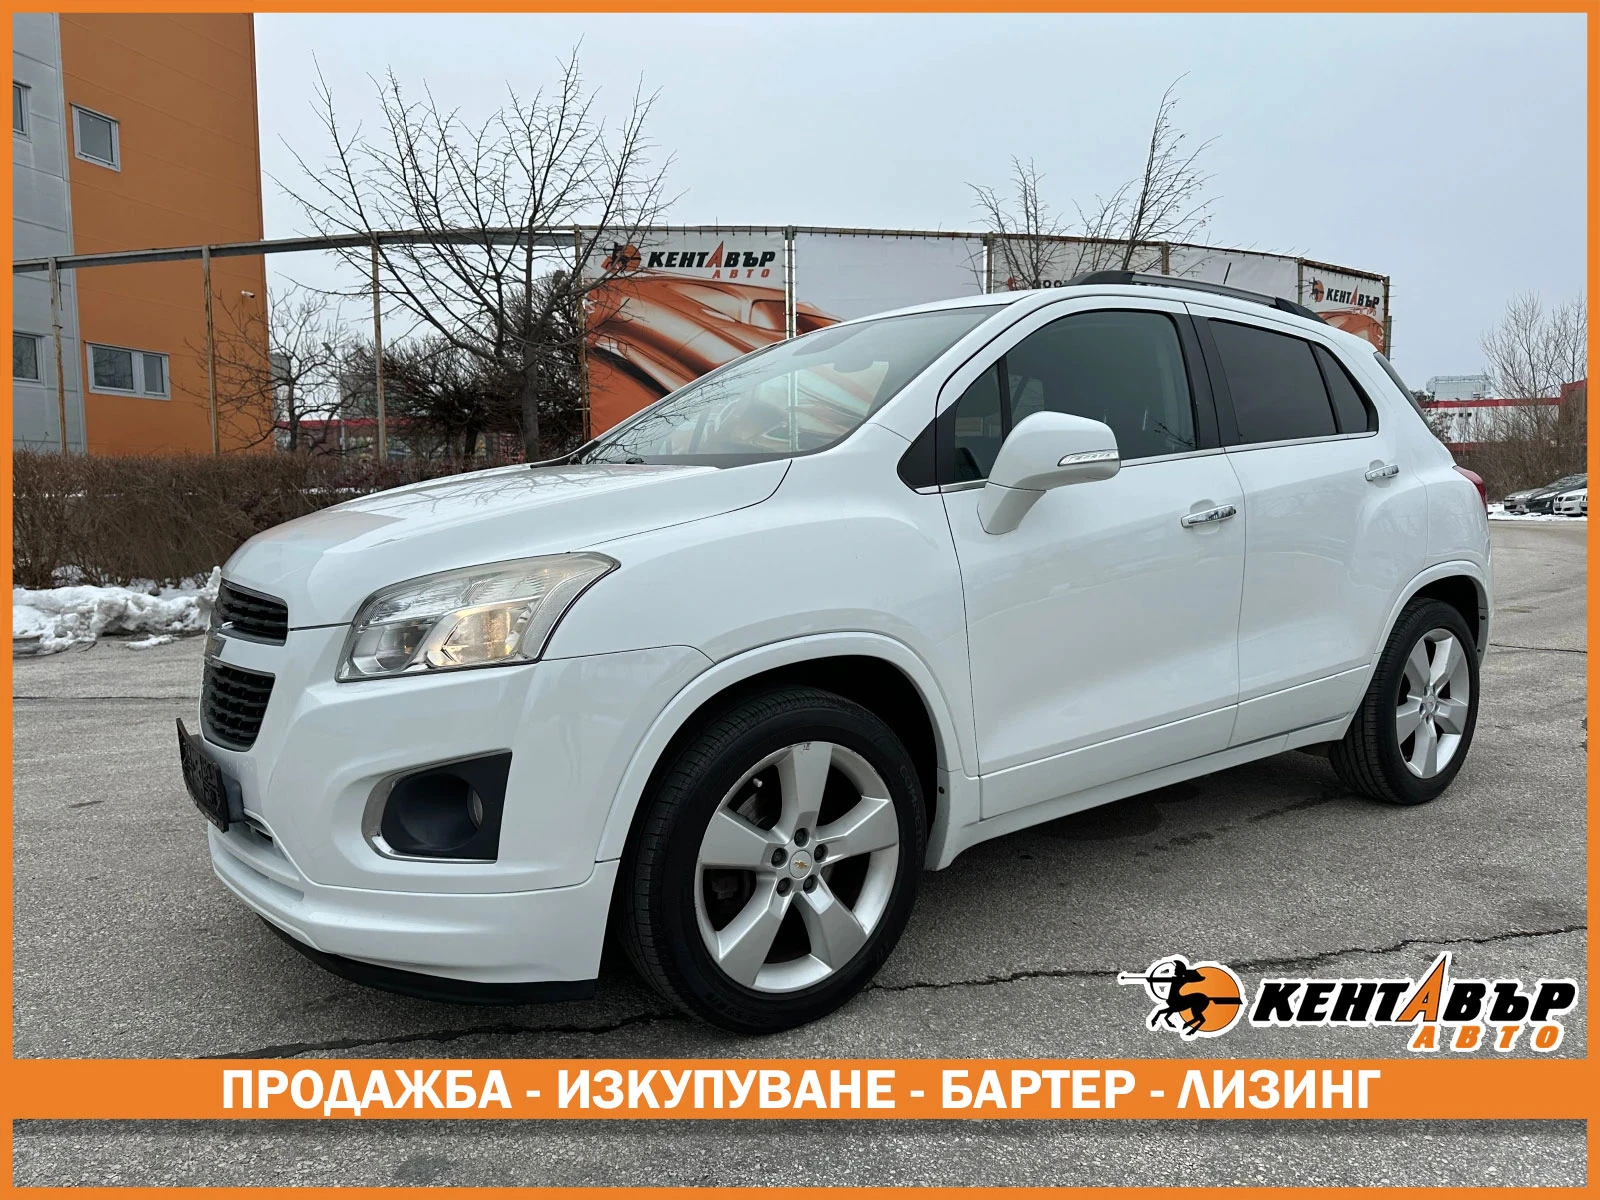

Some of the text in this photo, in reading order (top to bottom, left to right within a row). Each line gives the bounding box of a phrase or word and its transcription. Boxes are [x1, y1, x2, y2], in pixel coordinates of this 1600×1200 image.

[647, 240, 776, 268] КЕНТАВЪР
[712, 268, 770, 279] АВТО
[1325, 284, 1379, 308] КЕНТАВЪР
